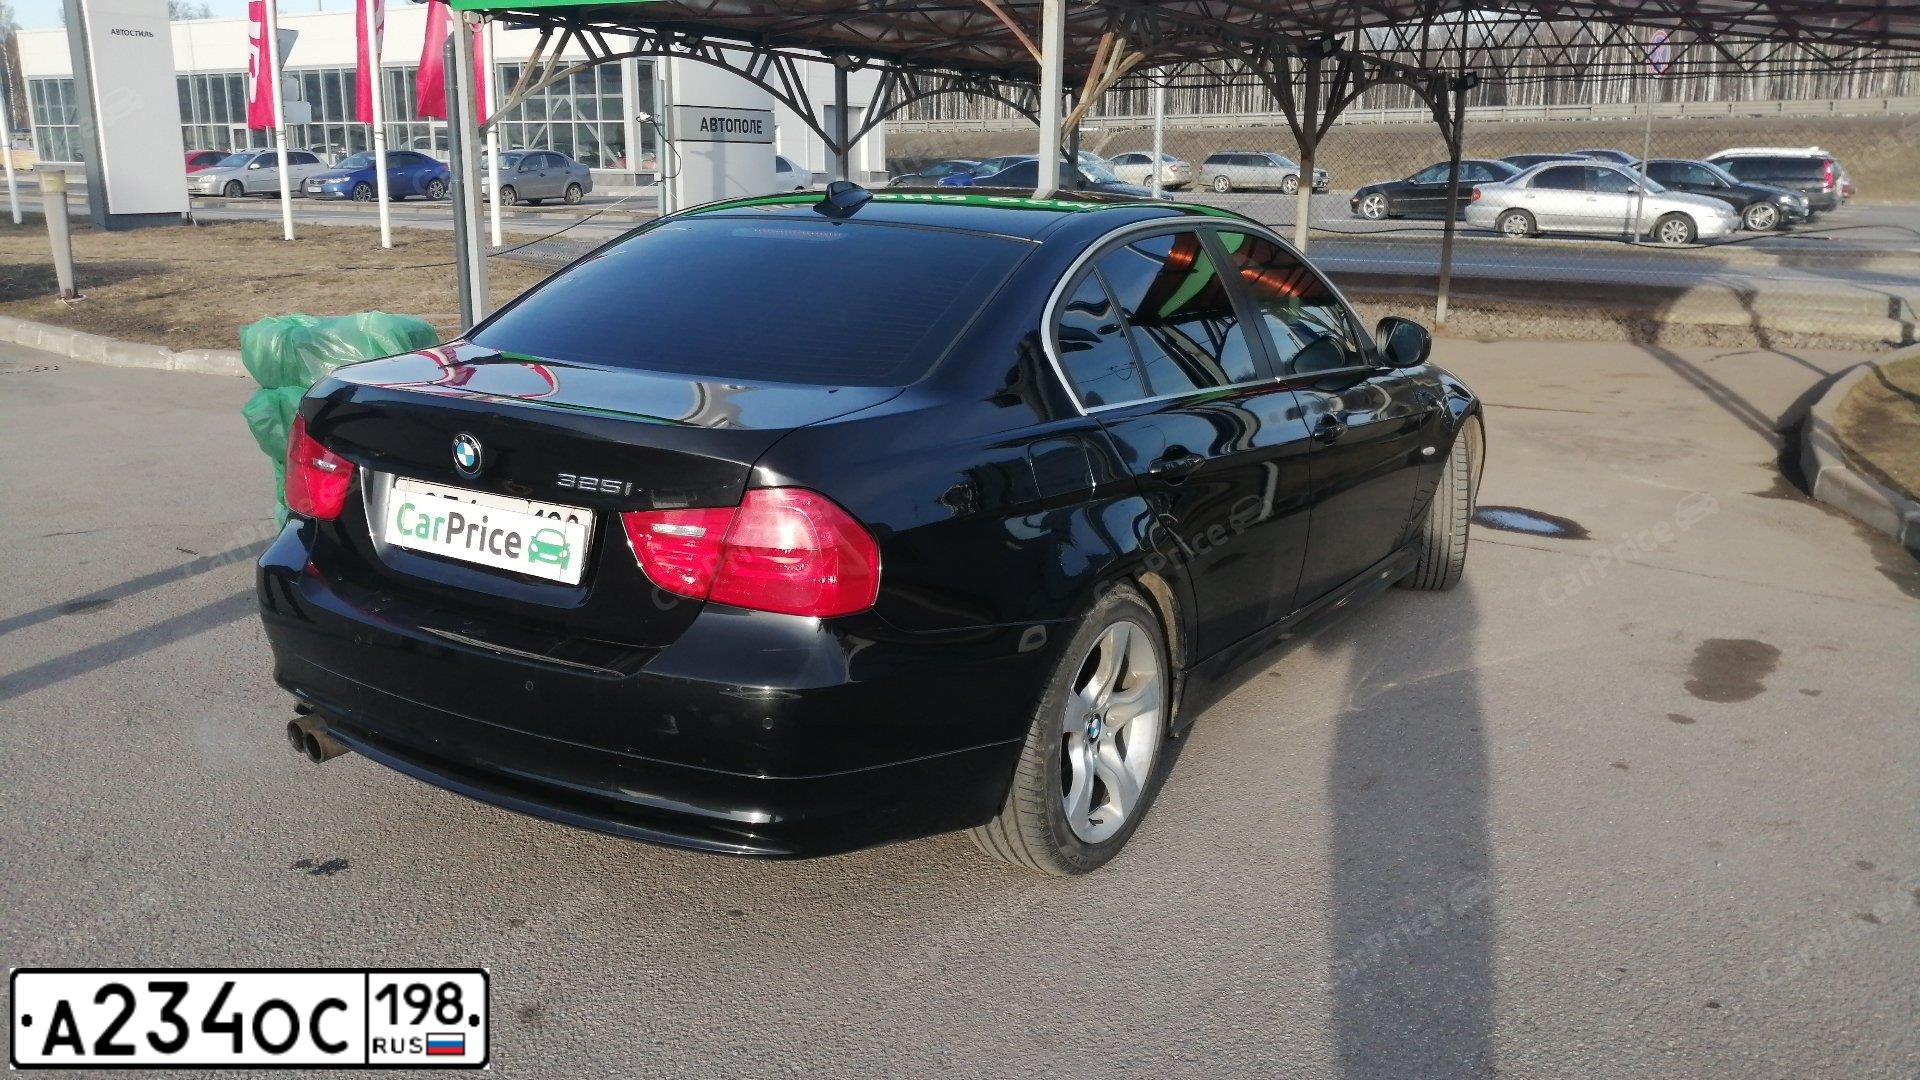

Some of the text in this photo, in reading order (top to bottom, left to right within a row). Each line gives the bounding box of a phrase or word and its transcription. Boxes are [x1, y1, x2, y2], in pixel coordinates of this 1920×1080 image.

[111, 28, 154, 38] АВТОСТИЛЬ
[700, 117, 763, 134] АВТОПОЛЕ
[396, 502, 522, 559] CarPrice
